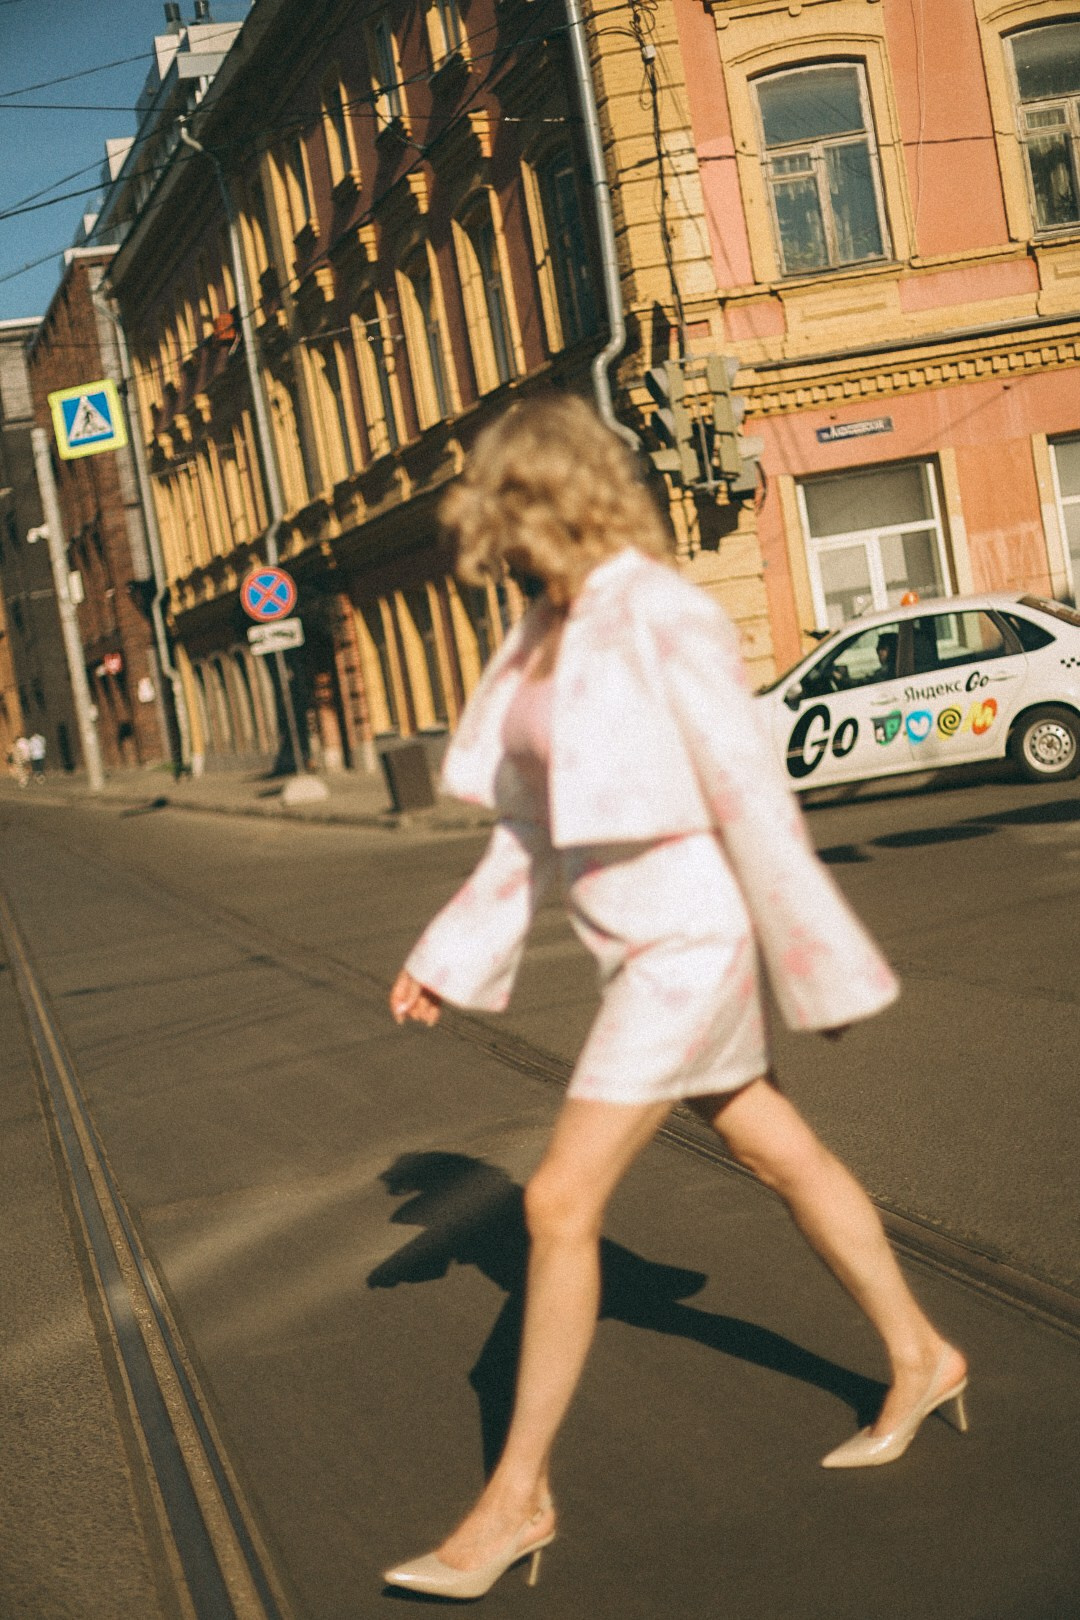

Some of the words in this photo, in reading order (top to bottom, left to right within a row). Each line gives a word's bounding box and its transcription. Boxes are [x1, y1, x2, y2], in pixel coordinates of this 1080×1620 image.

[904, 681, 962, 701] Яндекс
[965, 671, 989, 692] Go
[787, 704, 858, 778] Go
